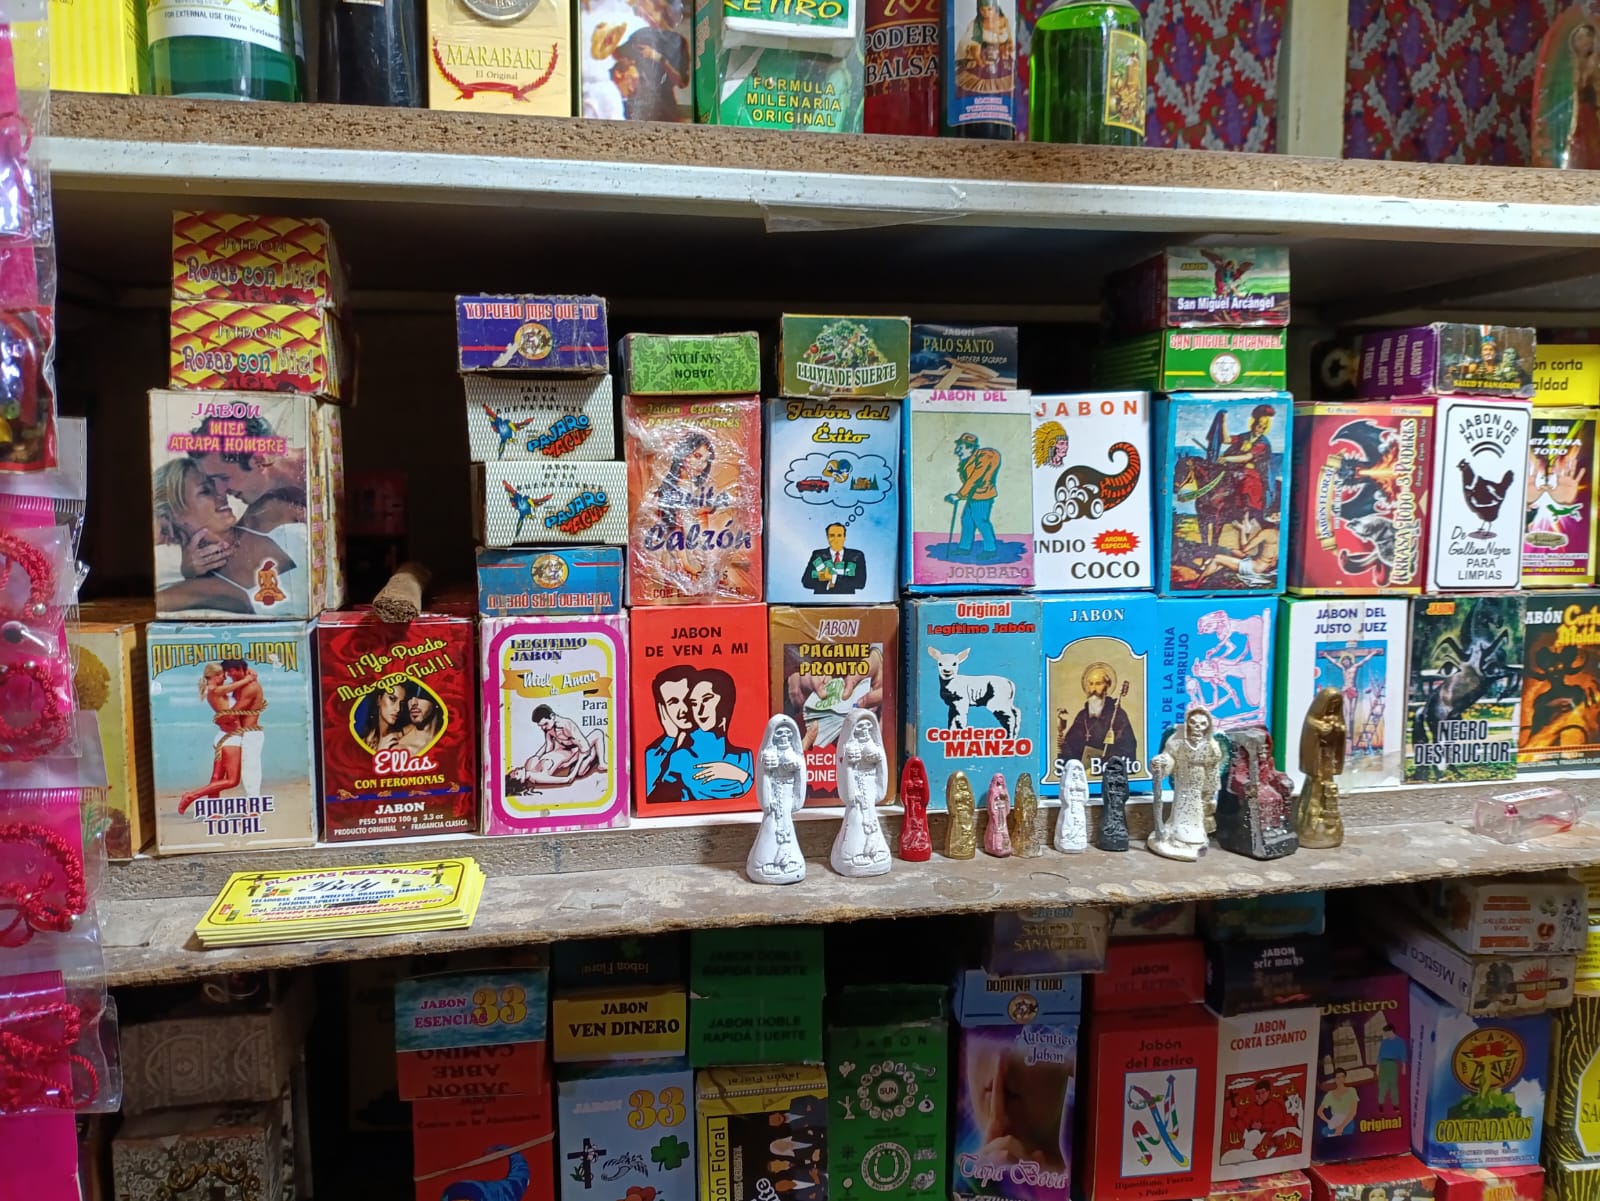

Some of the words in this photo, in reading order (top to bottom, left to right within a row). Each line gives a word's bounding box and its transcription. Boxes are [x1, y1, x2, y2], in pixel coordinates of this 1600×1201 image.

[176, 10, 207, 18] EXTERNAL
[446, 44, 544, 71] MARABAKI
[475, 70, 484, 79] El
[486, 70, 518, 82] Original
[753, 77, 836, 95] FORMULA
[746, 93, 842, 112] MILENARIA
[752, 109, 836, 127] ORIGINAL
[184, 256, 239, 283] Rosas
[241, 265, 277, 287] con
[463, 303, 483, 319] YO
[484, 303, 523, 319] PUEDO
[525, 303, 553, 321] MAS
[554, 303, 579, 320] QUE
[579, 303, 599, 320] TU
[1177, 297, 1196, 310] San
[1197, 297, 1230, 312] Miguel
[923, 337, 954, 352] PALO
[955, 338, 994, 353] SANTO
[1170, 334, 1190, 350] SAN
[1191, 334, 1230, 351] MIGUEL
[181, 345, 234, 373] Rosas
[236, 352, 272, 374] con
[698, 353, 722, 364] SAN
[1551, 359, 1583, 371] corta
[798, 362, 836, 385] LLUVIA
[837, 368, 852, 386] DE
[854, 363, 897, 385] SUERTE
[929, 390, 976, 402] JABON
[983, 390, 1007, 402] DEL
[191, 401, 262, 419] JABON
[787, 402, 851, 421] Jabón
[856, 405, 890, 420] del
[1035, 400, 1138, 417] JABON
[208, 420, 247, 437] MIEL
[526, 414, 589, 453] PAJARO
[812, 422, 869, 444] Éxito
[1458, 413, 1501, 435] JABON
[1505, 421, 1520, 437] DE
[1539, 425, 1569, 434] JABON
[168, 435, 220, 452] ATRAPA
[223, 437, 287, 454] HOMBRE
[1464, 428, 1512, 446] HUEVO
[1397, 476, 1411, 486] 3
[544, 491, 607, 529] PAJARO
[1395, 491, 1414, 526] TODO
[644, 520, 752, 551] Calzón
[1105, 535, 1128, 543] AROMA
[1451, 525, 1467, 540] De
[1033, 539, 1086, 554] INDIO
[1100, 542, 1131, 550] ESPECIAL
[1070, 560, 1140, 579] COCO
[1466, 557, 1496, 568] PARA
[947, 566, 1030, 582] JOROBADO
[1458, 570, 1502, 581] LIMPIAS
[506, 592, 529, 609] QUE
[558, 592, 594, 608] PUEDO
[957, 602, 1011, 620] Original
[1068, 608, 1125, 622] JABON
[1316, 608, 1358, 619] JABON
[1365, 607, 1386, 618] DEL
[671, 626, 722, 640] JABON
[816, 619, 860, 641] JABON
[992, 621, 1036, 633] Jabón
[1314, 623, 1351, 634] JUSTO
[1359, 621, 1388, 633] JUEZ
[390, 638, 448, 662] Puedo
[510, 638, 588, 651] LEGITIMO
[645, 646, 664, 657] DE
[674, 644, 703, 656] VEN
[712, 643, 723, 655] A
[731, 642, 749, 654] MI
[799, 642, 870, 658] PAGAME
[1164, 626, 1175, 662] REINA
[151, 643, 243, 680] AUTENTICO
[243, 641, 299, 672] JABON
[510, 650, 562, 661] JABON
[1177, 633, 1189, 695] EMBRUJO
[799, 661, 870, 676] PRONTO
[337, 681, 374, 702] Mas
[371, 673, 409, 697] que
[522, 671, 551, 688] Miel
[561, 671, 598, 689] Amor
[1163, 670, 1173, 691] LA
[582, 700, 608, 711] Para
[1162, 696, 1172, 713] DE
[582, 714, 609, 727] Ellas
[927, 726, 1008, 742] Cordero
[1438, 720, 1488, 741] NEGRO
[944, 738, 1032, 758] MANZO
[1414, 742, 1510, 766] DESTRUCTOR
[373, 750, 439, 774] Ellas
[354, 778, 377, 789] CON
[379, 774, 445, 788] FEROMONAS
[194, 796, 275, 818] AMARRE
[374, 802, 426, 815] JABON
[205, 815, 266, 836] TOTAL
[358, 816, 376, 825] PESO
[378, 815, 397, 824] NETO
[399, 815, 411, 824] 100
[411, 821, 443, 831] FRAGANCIA
[445, 819, 468, 828] CLASICA
[334, 827, 367, 836] PRODUCTO
[368, 825, 397, 834] ORIGINAL
[264, 872, 337, 886] PLANTAS
[986, 979, 1031, 993] DOMINA
[420, 998, 466, 1010] JABON
[472, 985, 528, 1027] 33
[601, 1002, 648, 1015] JABON
[414, 1012, 488, 1029] ESENCIAS
[569, 1022, 607, 1037] VEN
[611, 1018, 680, 1036] DINERO
[708, 1017, 753, 1029] JABON
[1253, 1019, 1286, 1034] JABON
[703, 1031, 751, 1043] RAPIDA
[853, 1035, 927, 1049] JABON
[1230, 1035, 1262, 1050] CORTA
[1265, 1030, 1307, 1047] ESPANTO
[1125, 1055, 1148, 1070] del
[1152, 1053, 1194, 1068] Retiro
[432, 1063, 501, 1079] ABRE
[427, 1082, 510, 1097] JABON
[880, 1086, 897, 1095] SUN
[627, 1086, 687, 1130] 33
[1360, 1116, 1402, 1133] Original
[1435, 1111, 1532, 1143] CONTRADAÑOS
[711, 1126, 727, 1172] Floral
